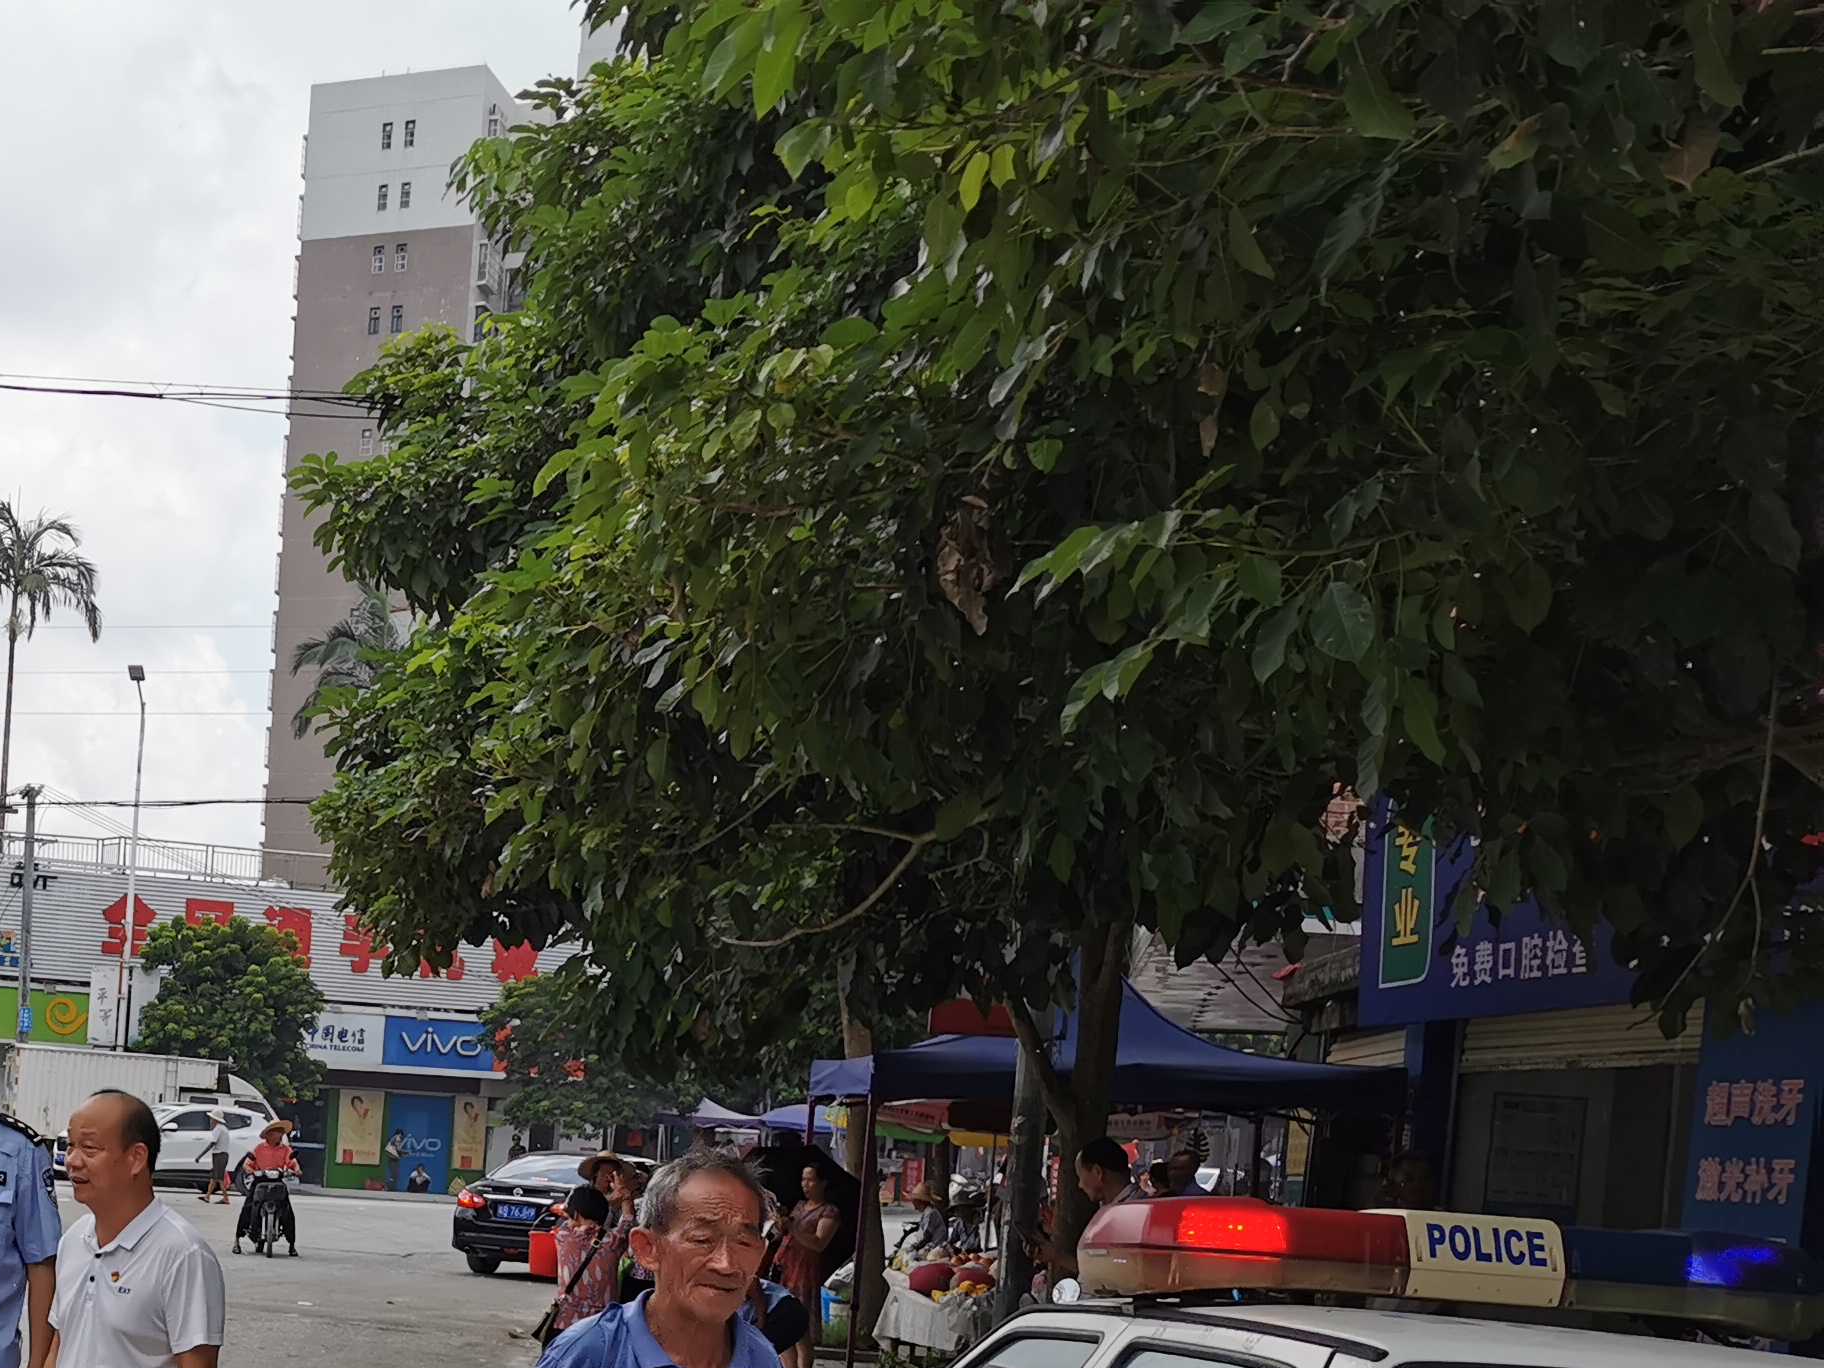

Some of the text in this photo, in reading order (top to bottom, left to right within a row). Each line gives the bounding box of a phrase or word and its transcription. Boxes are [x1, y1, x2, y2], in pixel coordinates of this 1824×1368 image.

[307, 1024, 366, 1045] 中国电信
[329, 1044, 365, 1053] TELECOM
[401, 1026, 482, 1056] vivo
[1704, 1079, 1805, 1127] 超声洗牙
[1695, 1157, 1796, 1205] 激光补牙
[1426, 1223, 1548, 1267] POLICE
